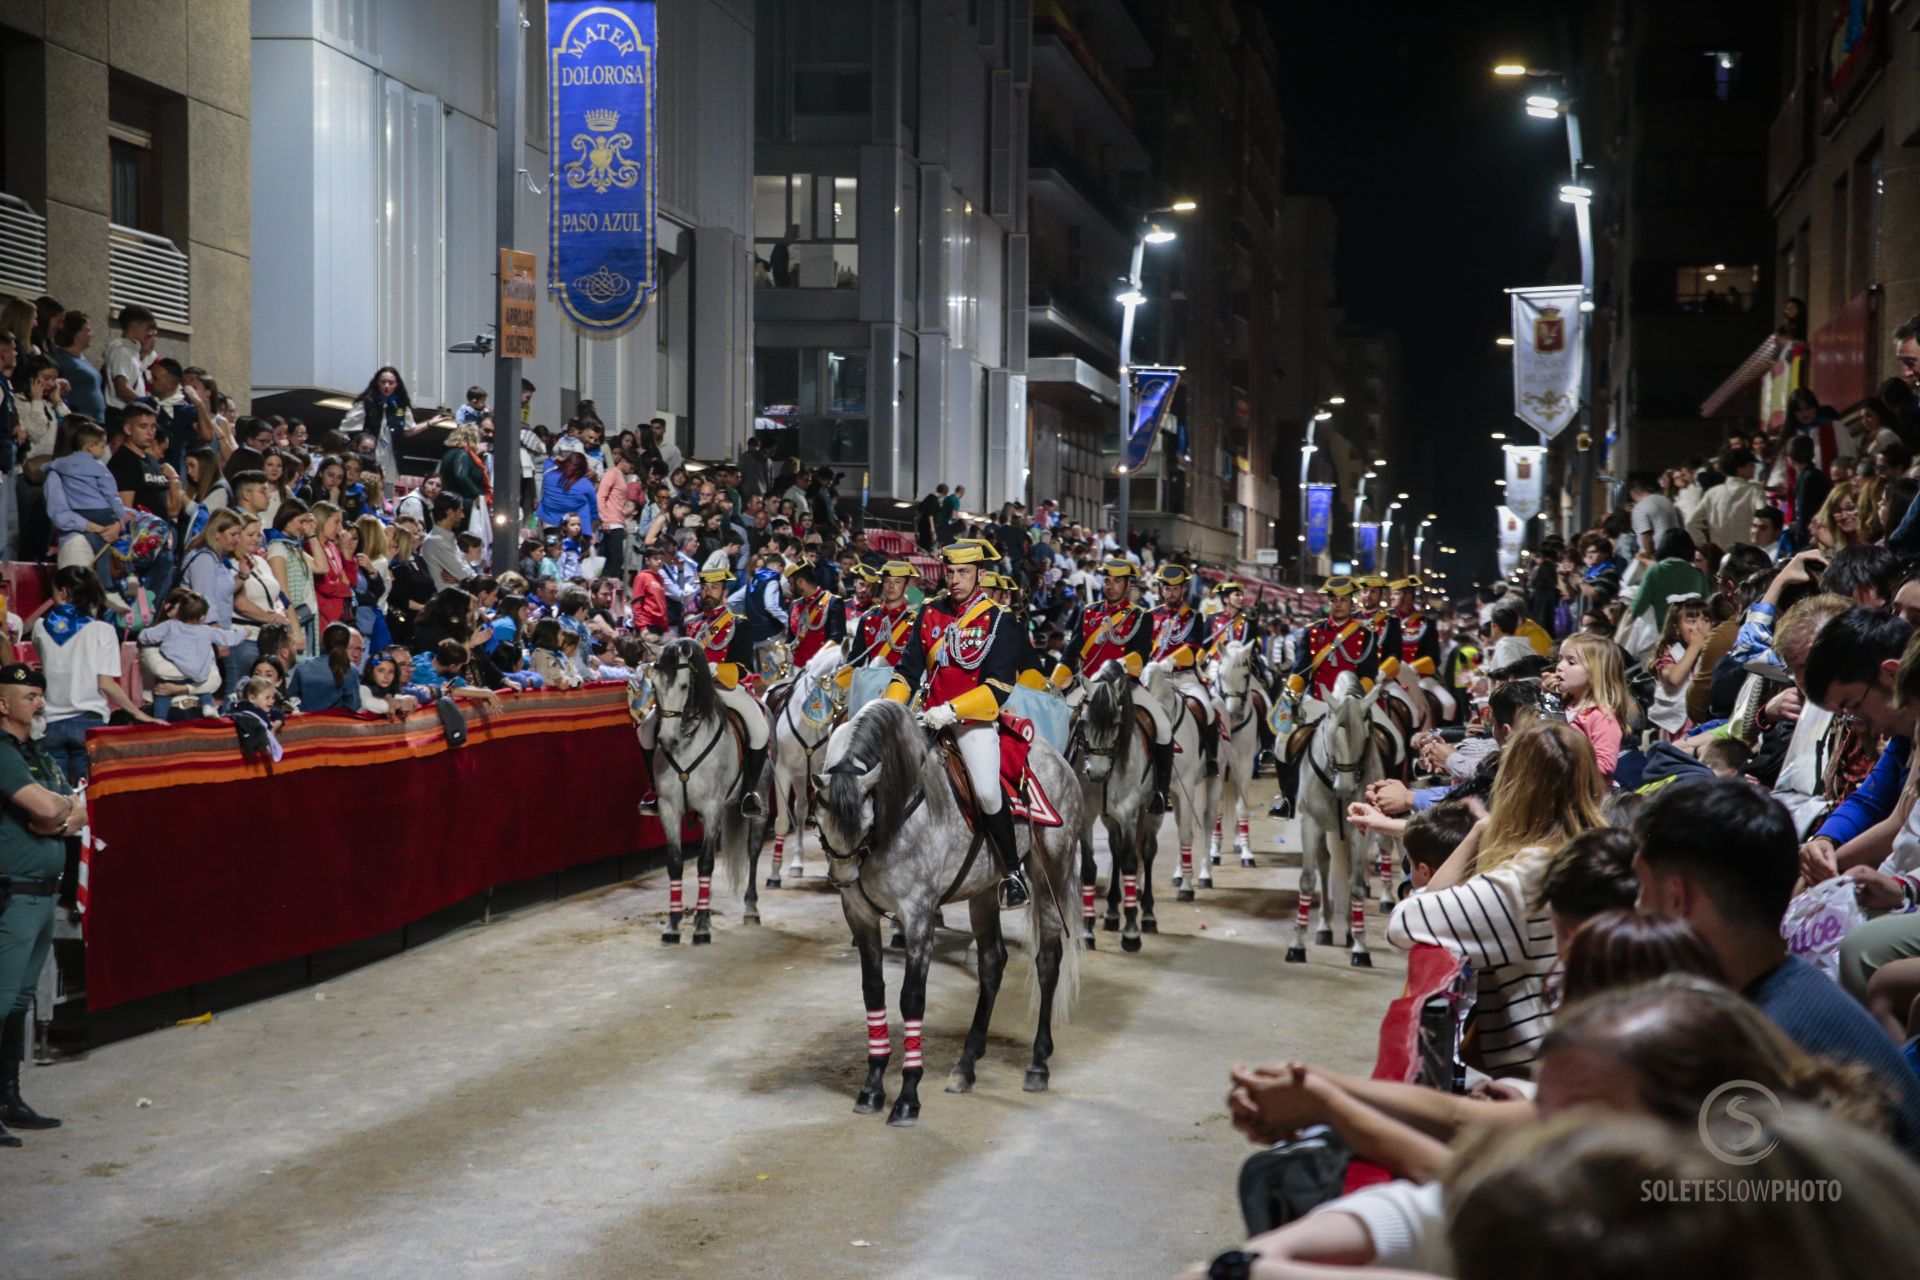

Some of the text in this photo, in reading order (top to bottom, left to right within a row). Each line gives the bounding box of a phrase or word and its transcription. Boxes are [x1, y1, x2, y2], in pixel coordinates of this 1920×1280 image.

[567, 23, 635, 59] MATER
[562, 65, 645, 87] DOLOROSA
[562, 213, 643, 233] PASO AZUL
